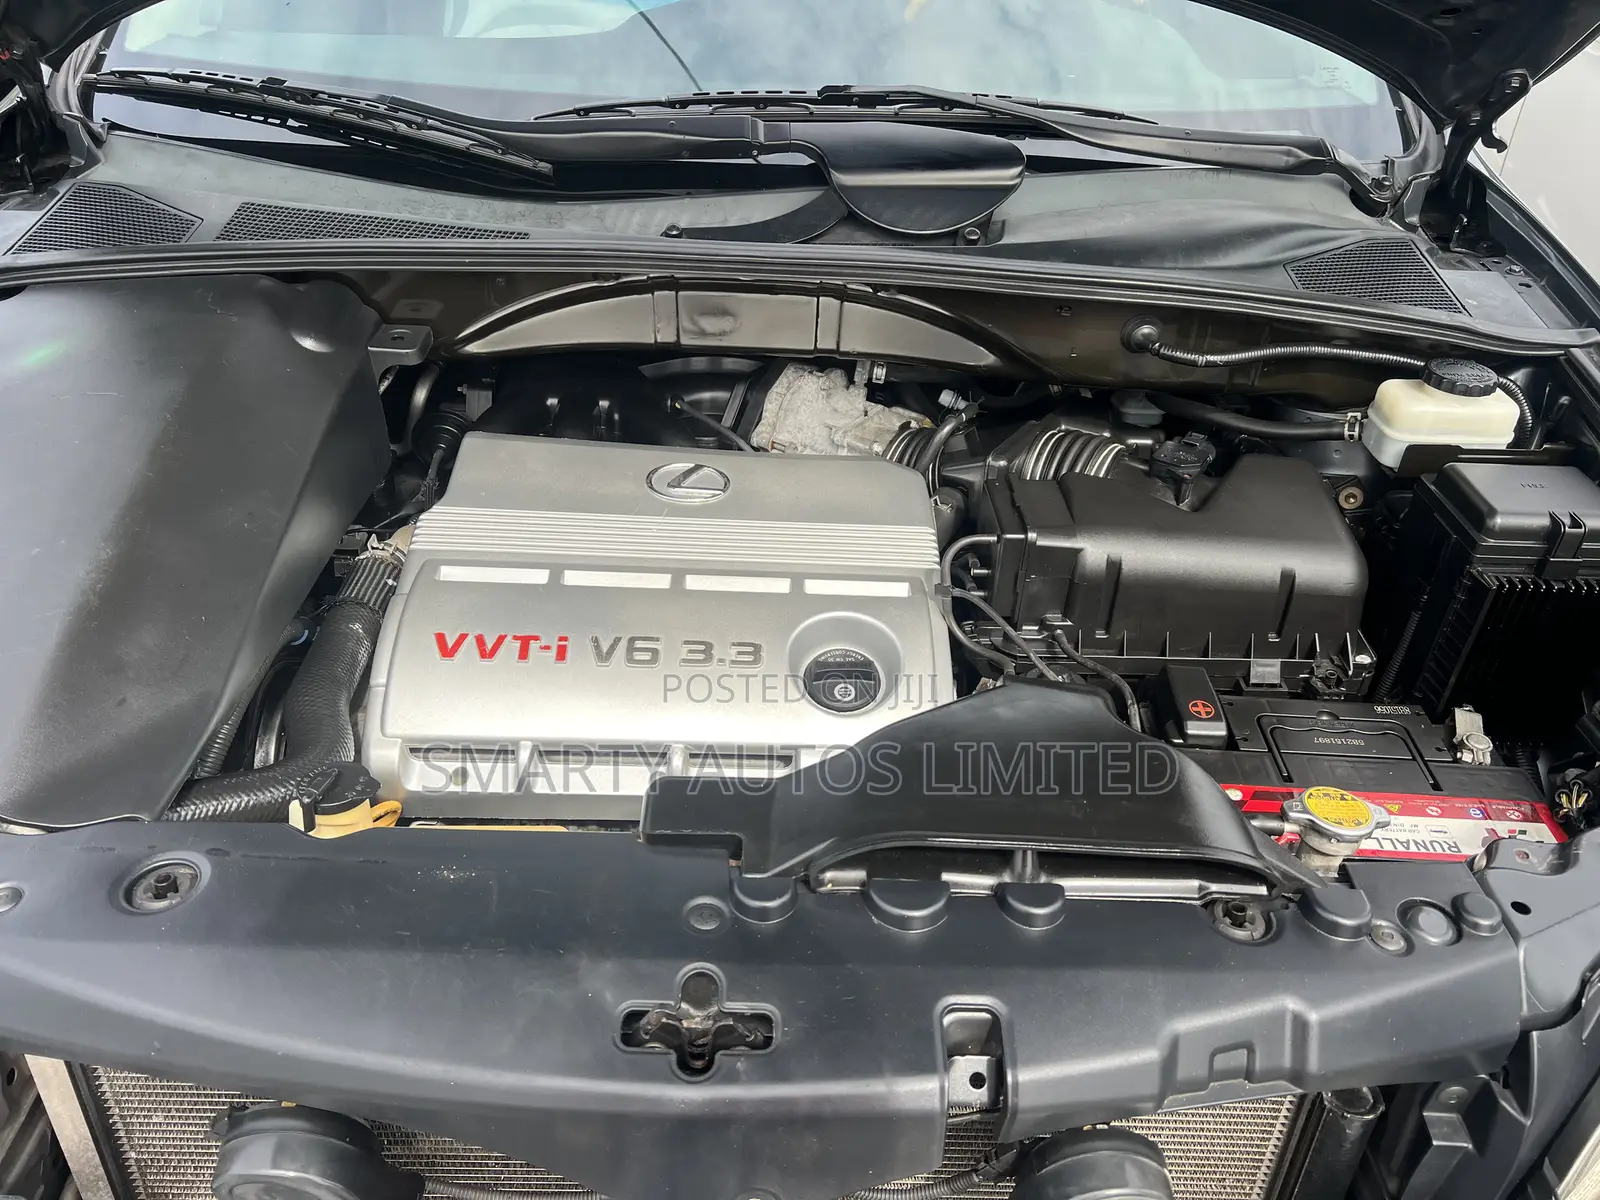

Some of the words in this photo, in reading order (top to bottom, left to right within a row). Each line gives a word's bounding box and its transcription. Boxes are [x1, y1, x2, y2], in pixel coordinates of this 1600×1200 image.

[433, 631, 570, 664] VVT-i
[589, 635, 663, 668] V6
[679, 640, 765, 669] 3.3
